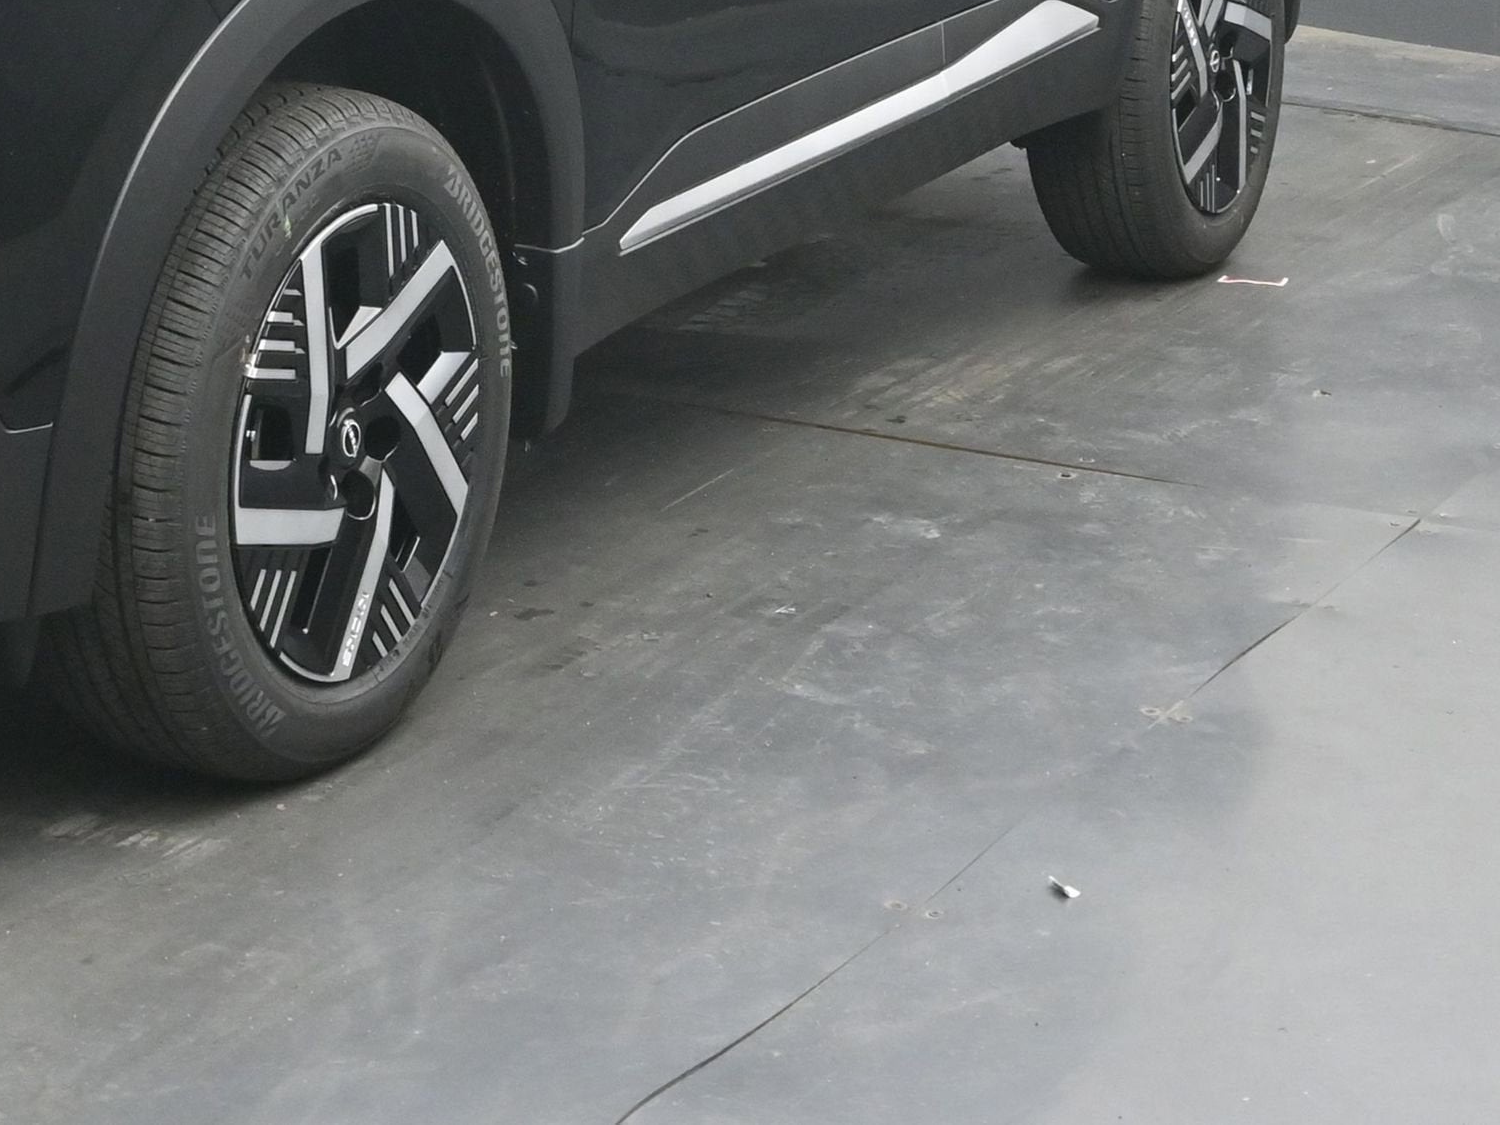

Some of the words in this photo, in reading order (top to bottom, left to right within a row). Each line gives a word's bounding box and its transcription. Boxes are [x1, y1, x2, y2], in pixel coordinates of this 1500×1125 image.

[241, 147, 343, 281] TURANZA
[443, 165, 512, 378] BRIDGESTONE
[196, 515, 286, 738] BRIDGESTONE
